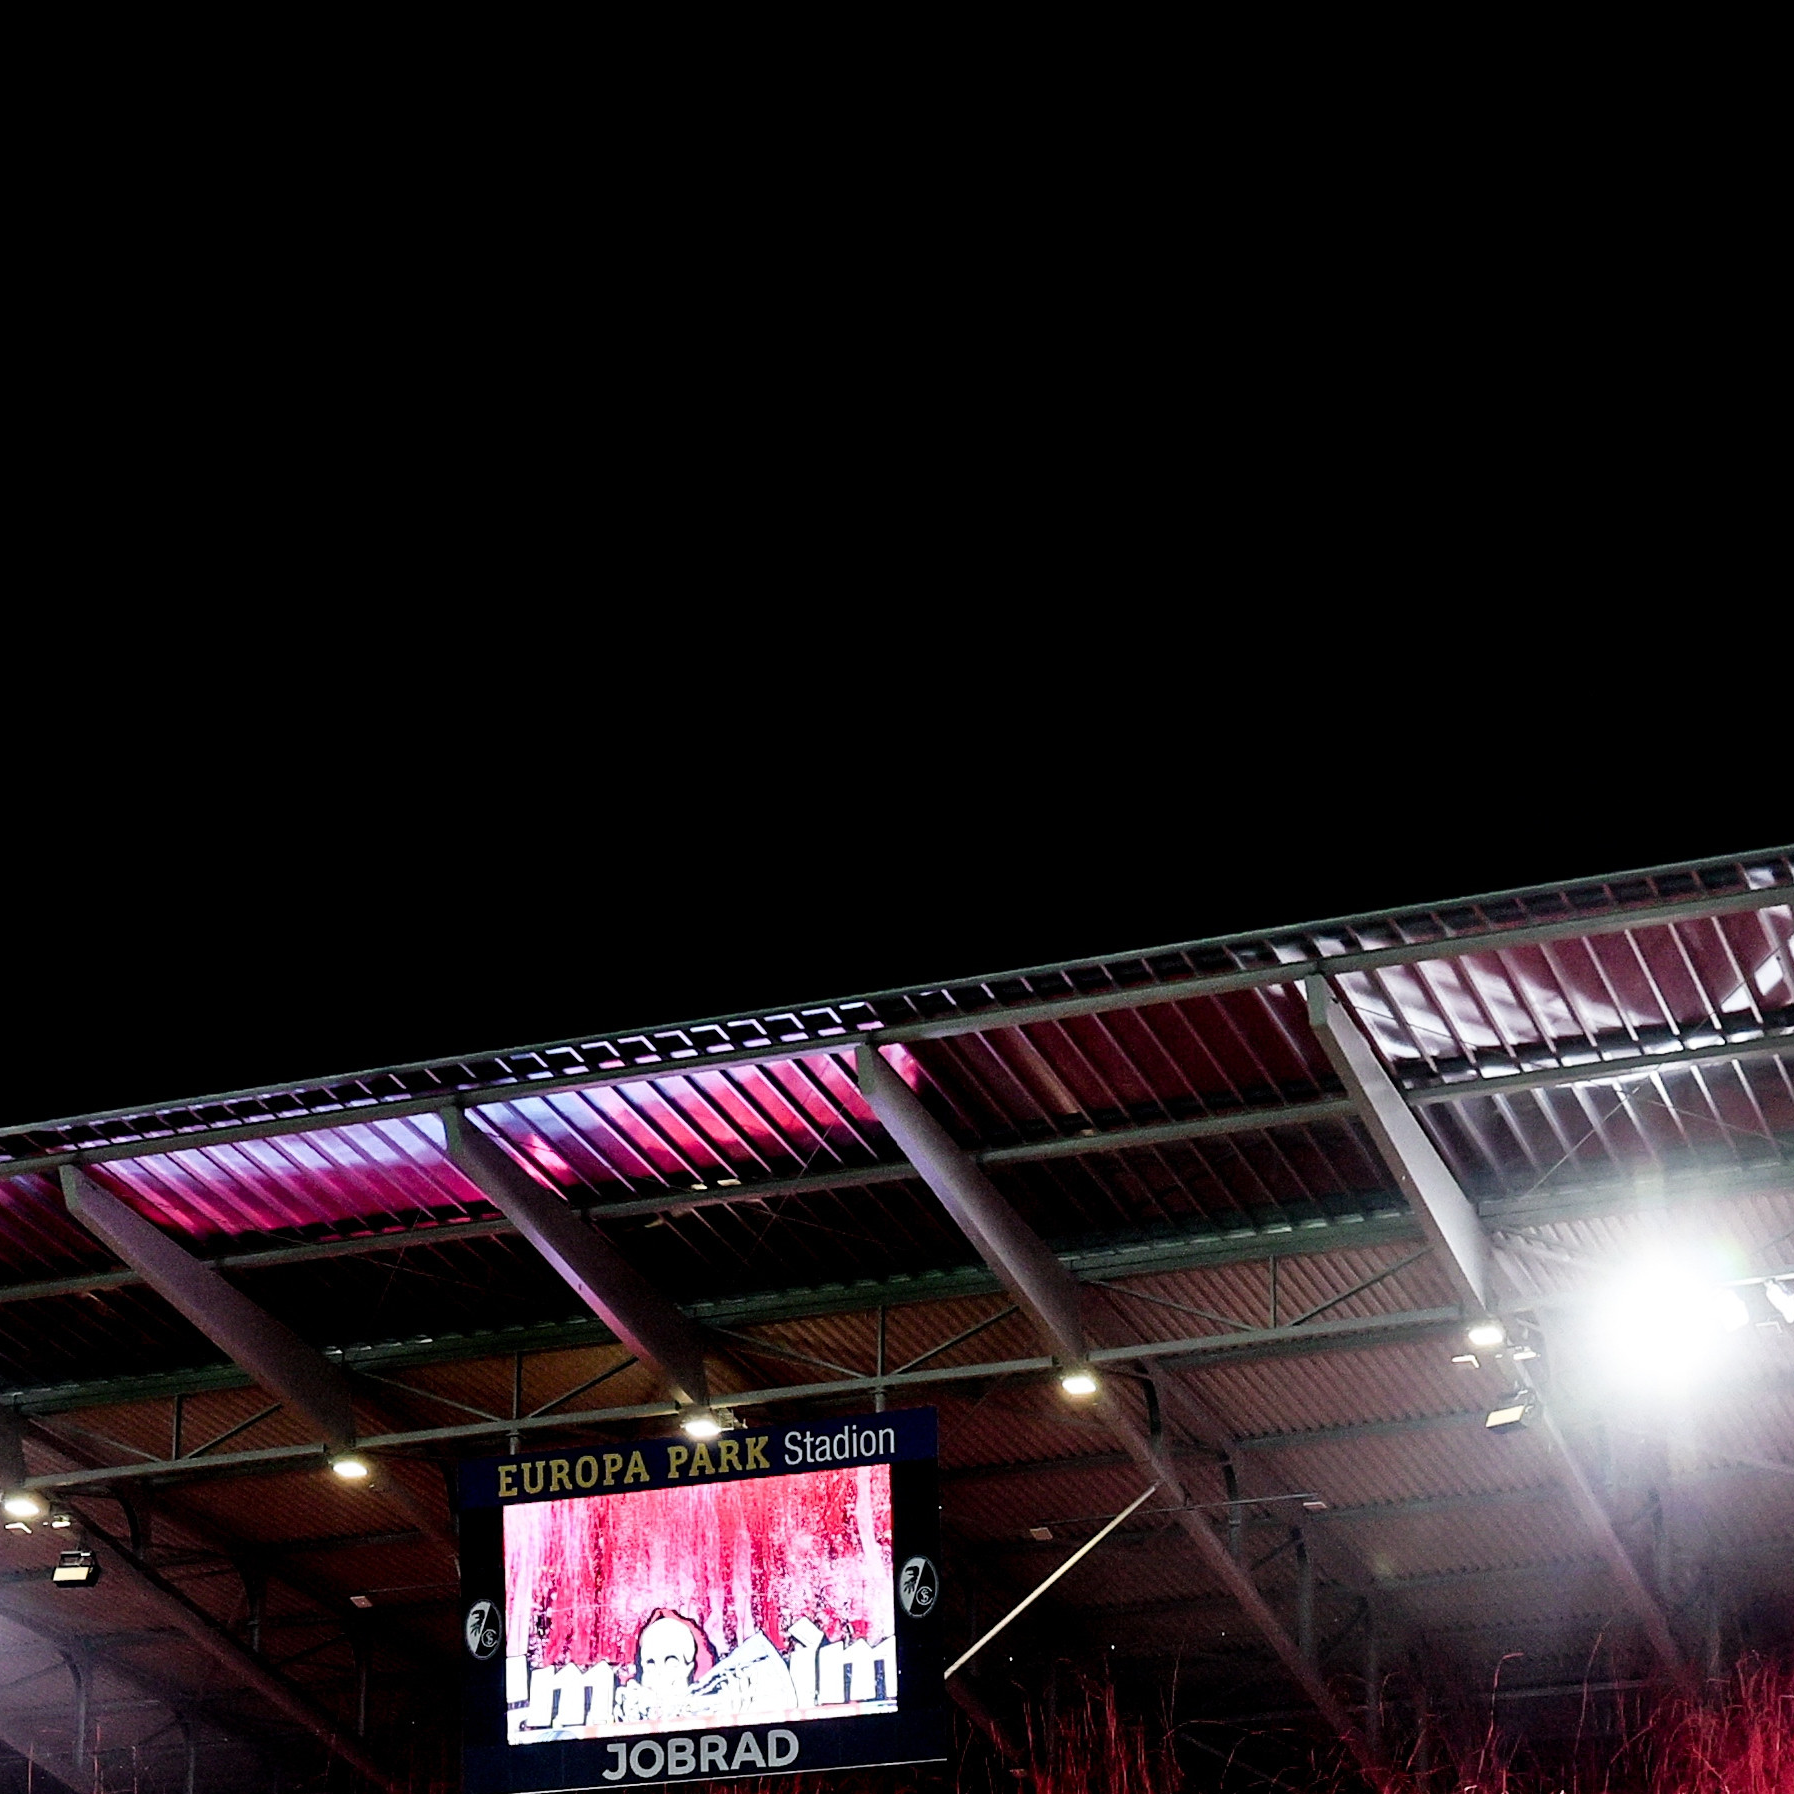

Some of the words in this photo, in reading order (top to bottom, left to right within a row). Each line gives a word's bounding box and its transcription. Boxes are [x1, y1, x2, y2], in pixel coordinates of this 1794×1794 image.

[498, 1451, 650, 1498] EUROPA
[667, 1434, 771, 1479] PARK
[784, 1424, 896, 1466] Stadion
[602, 1729, 800, 1781] JOBRAD
